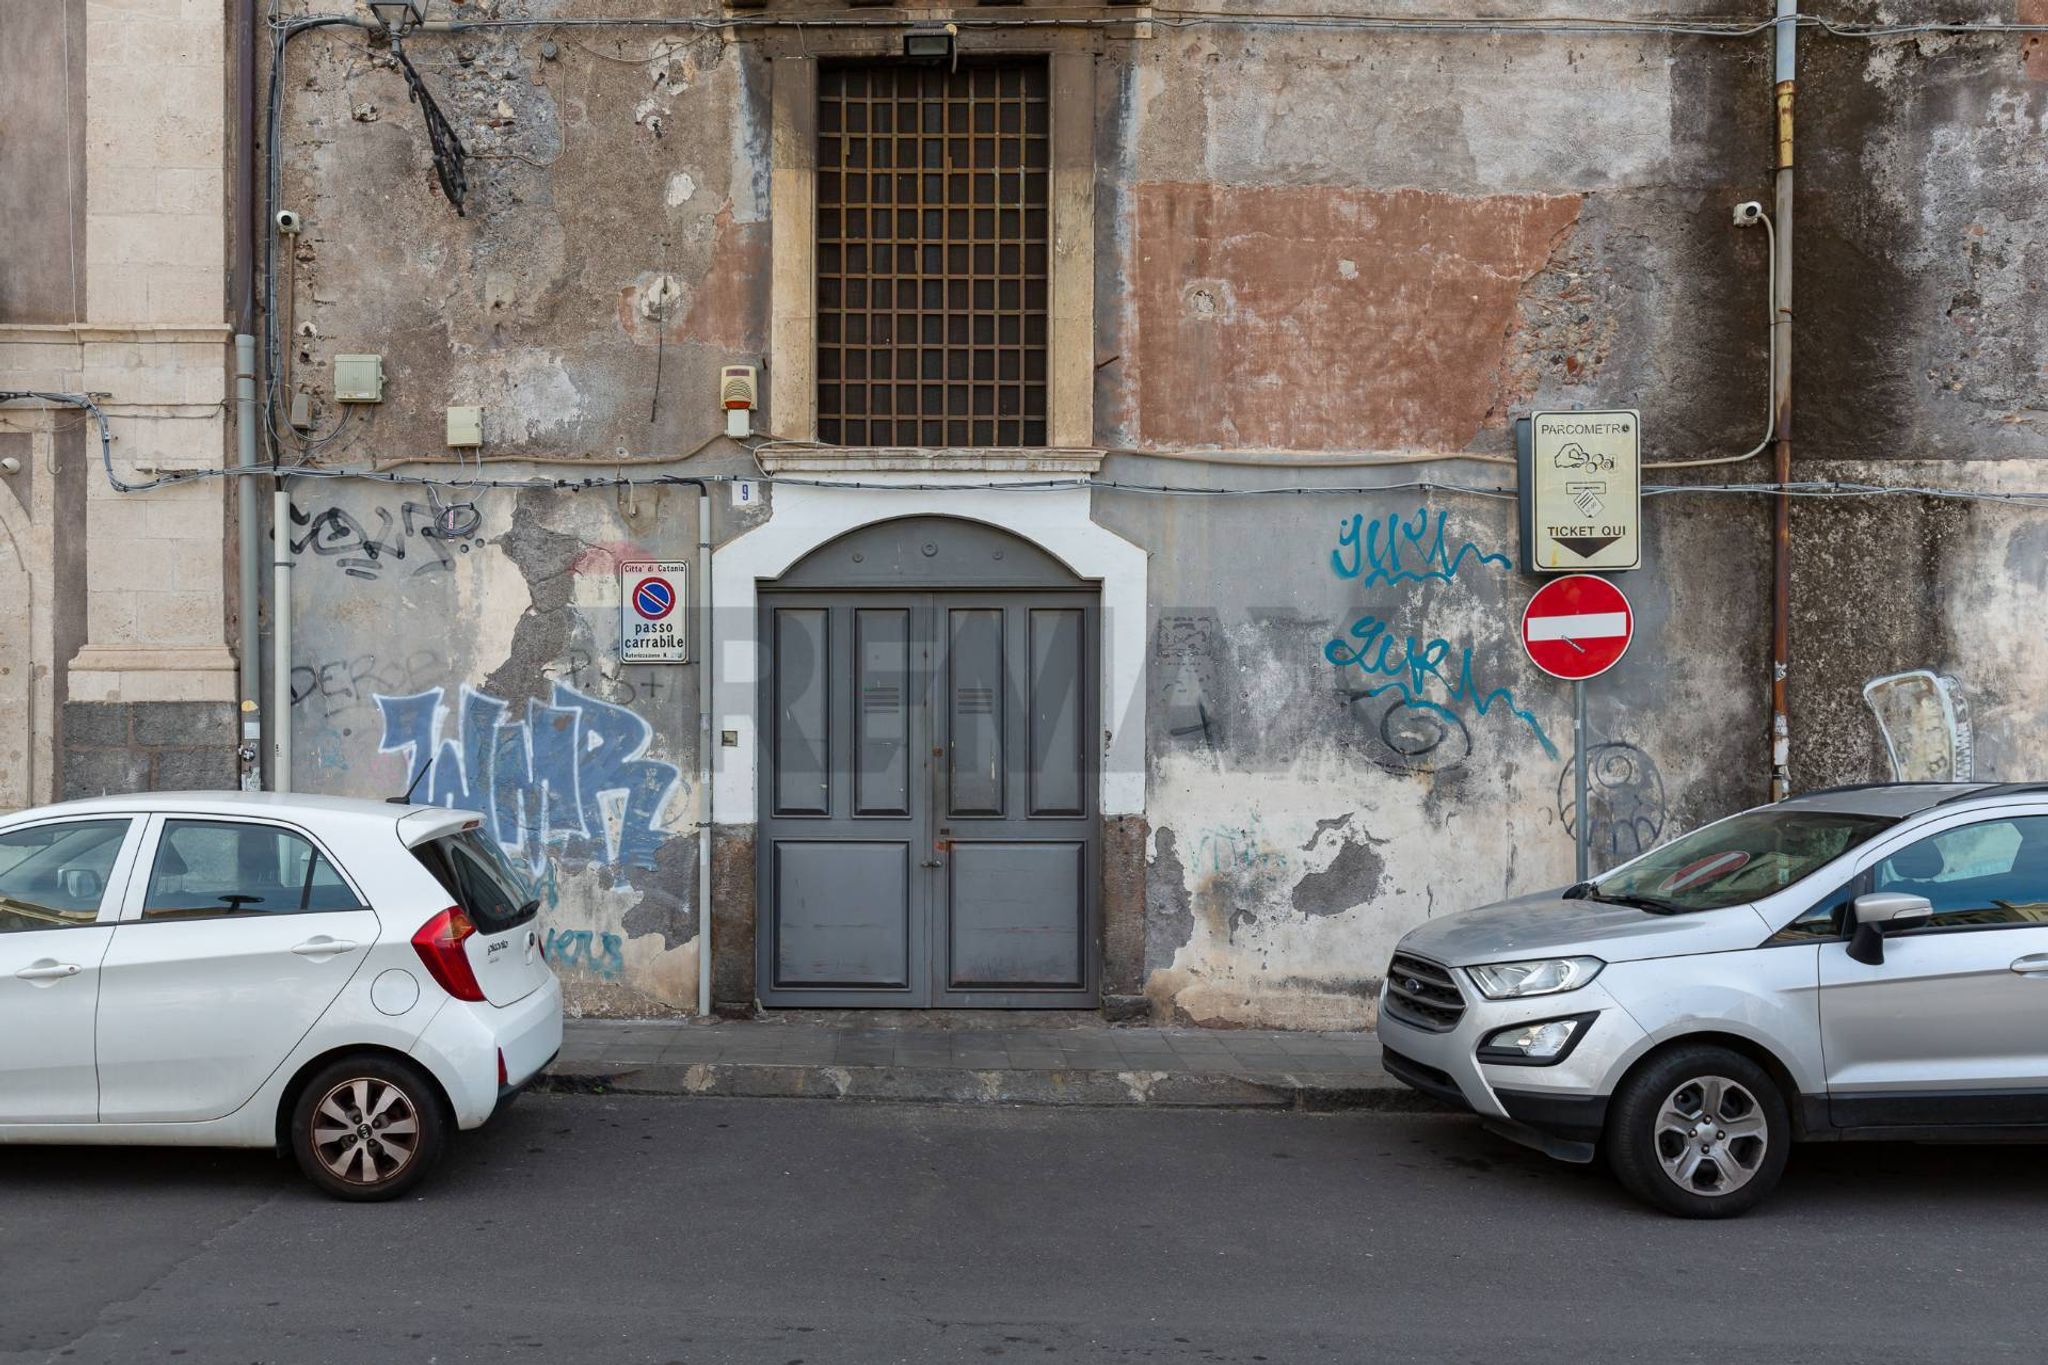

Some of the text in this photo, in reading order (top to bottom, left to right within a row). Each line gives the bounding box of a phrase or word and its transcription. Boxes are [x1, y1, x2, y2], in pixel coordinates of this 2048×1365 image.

[742, 484, 749, 501] 9
[1547, 525, 1626, 537] TICKET QUI
[647, 565, 654, 573] di
[657, 564, 685, 573] Catania
[635, 623, 673, 635] passo
[624, 635, 685, 649] carrabile
